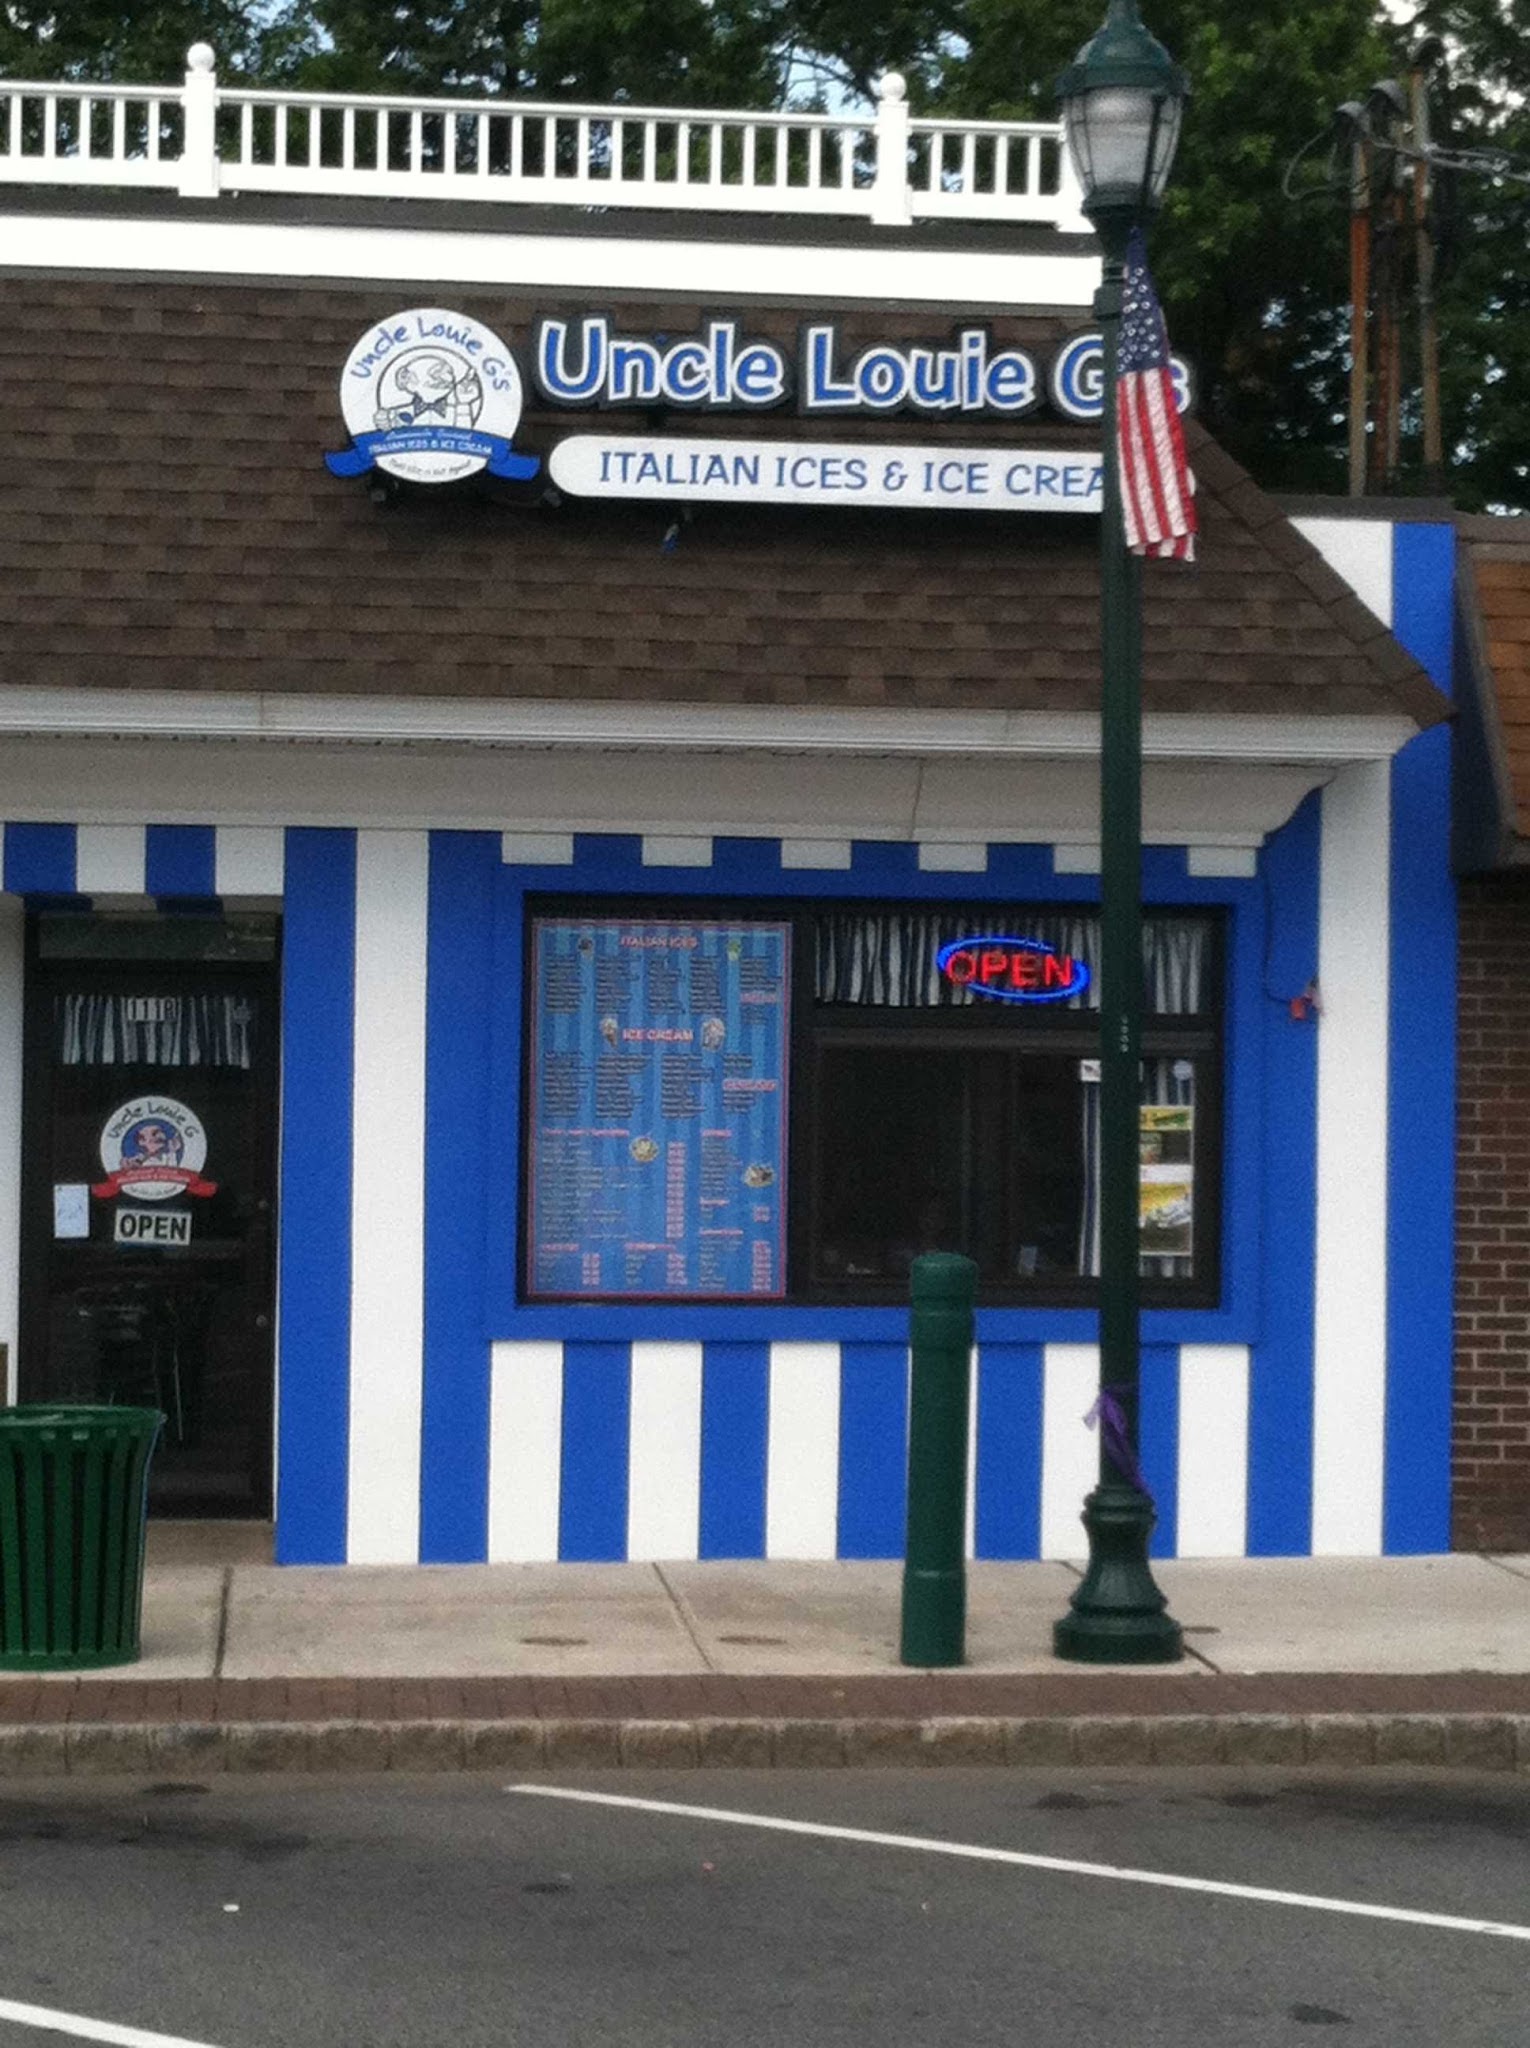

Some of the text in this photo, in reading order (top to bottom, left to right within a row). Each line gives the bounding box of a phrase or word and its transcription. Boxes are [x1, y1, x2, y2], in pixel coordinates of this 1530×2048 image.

[350, 326, 410, 378] Uncle
[417, 317, 483, 355] Louie
[539, 318, 784, 403] Uncle
[807, 327, 1036, 410] Louie
[600, 451, 1106, 498] ITALIAN ICES & ICE CREA
[946, 951, 1072, 987] OPEN
[107, 1107, 144, 1139] Uncle
[147, 1102, 186, 1125] Louie
[119, 1213, 187, 1240] OPEN
